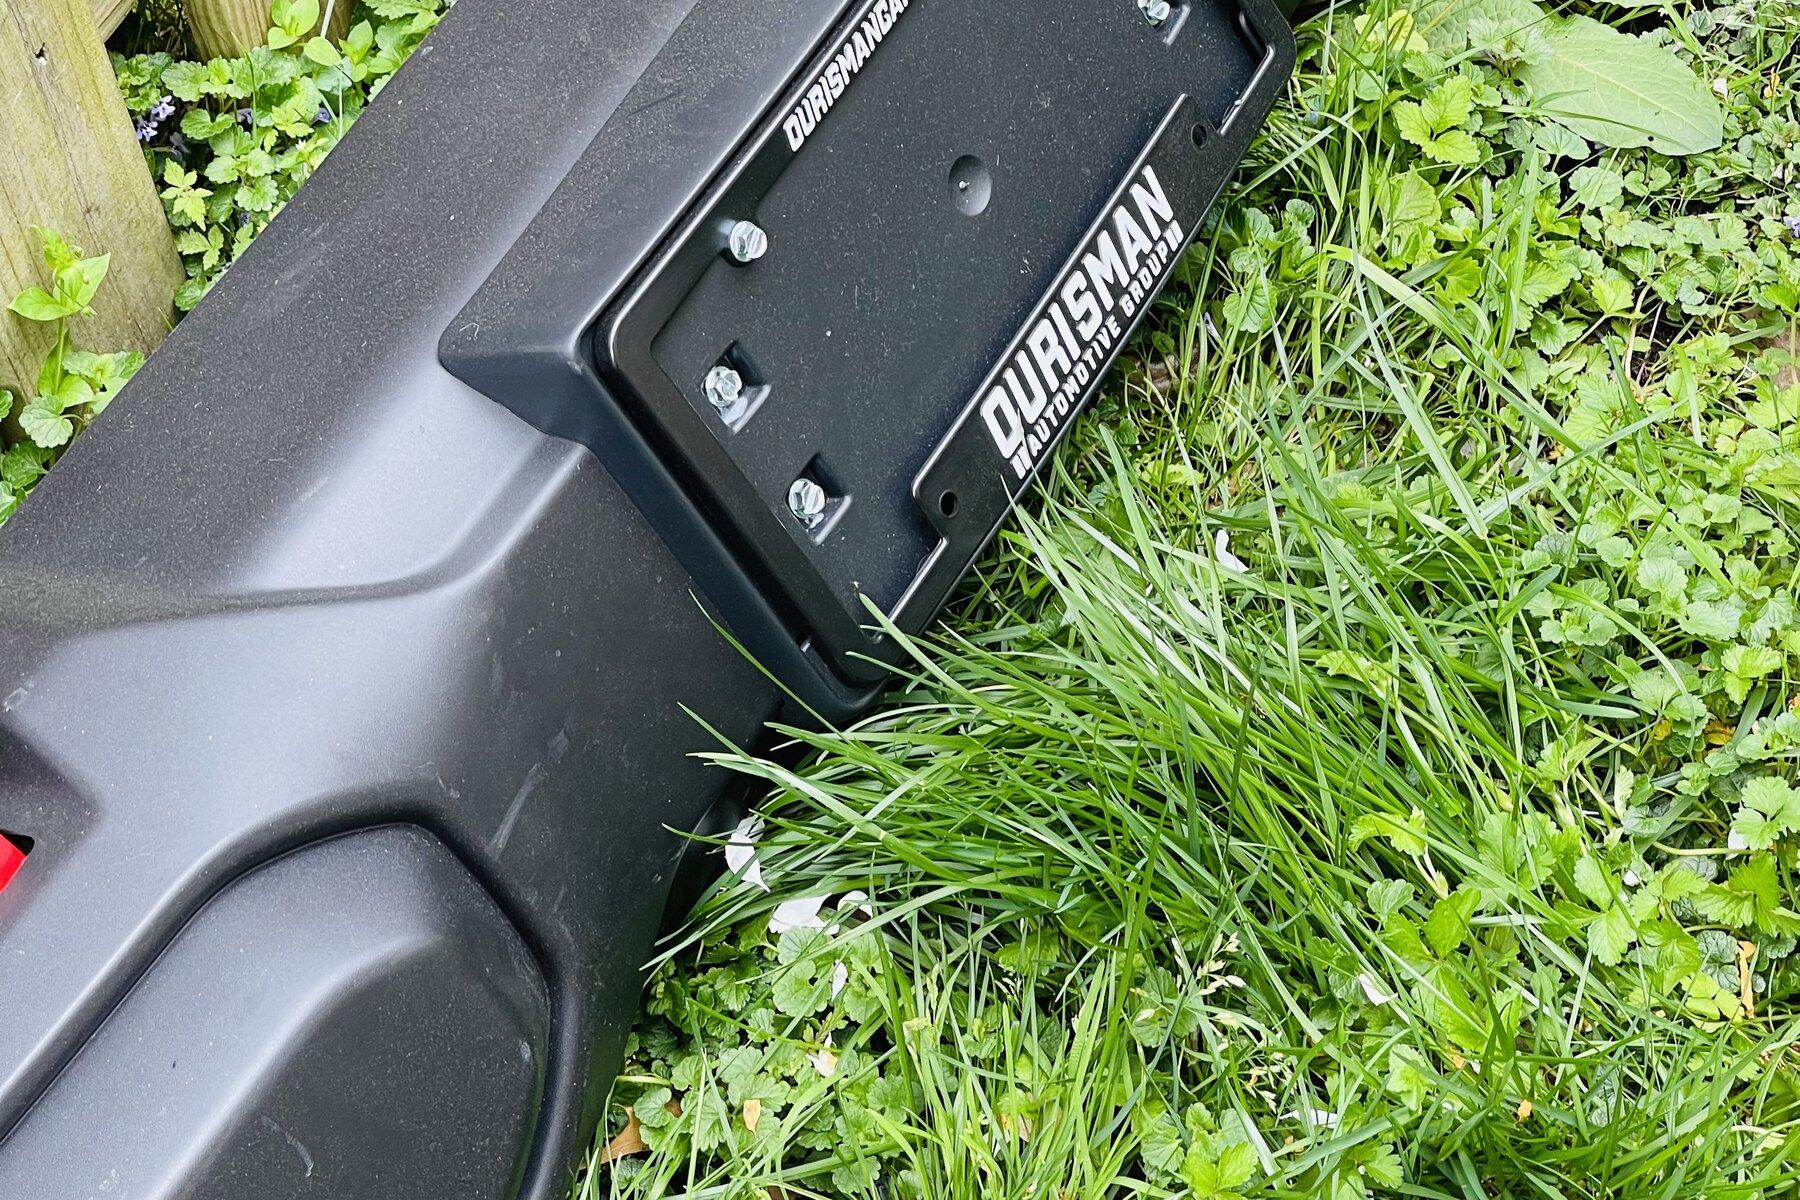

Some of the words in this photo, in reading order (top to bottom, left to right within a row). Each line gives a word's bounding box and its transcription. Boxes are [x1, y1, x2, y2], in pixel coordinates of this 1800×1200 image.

[980, 164, 1174, 459] OURISMAN
[1026, 315, 1121, 457] AUTOMOTIVE
[1119, 240, 1168, 318] GROUP
